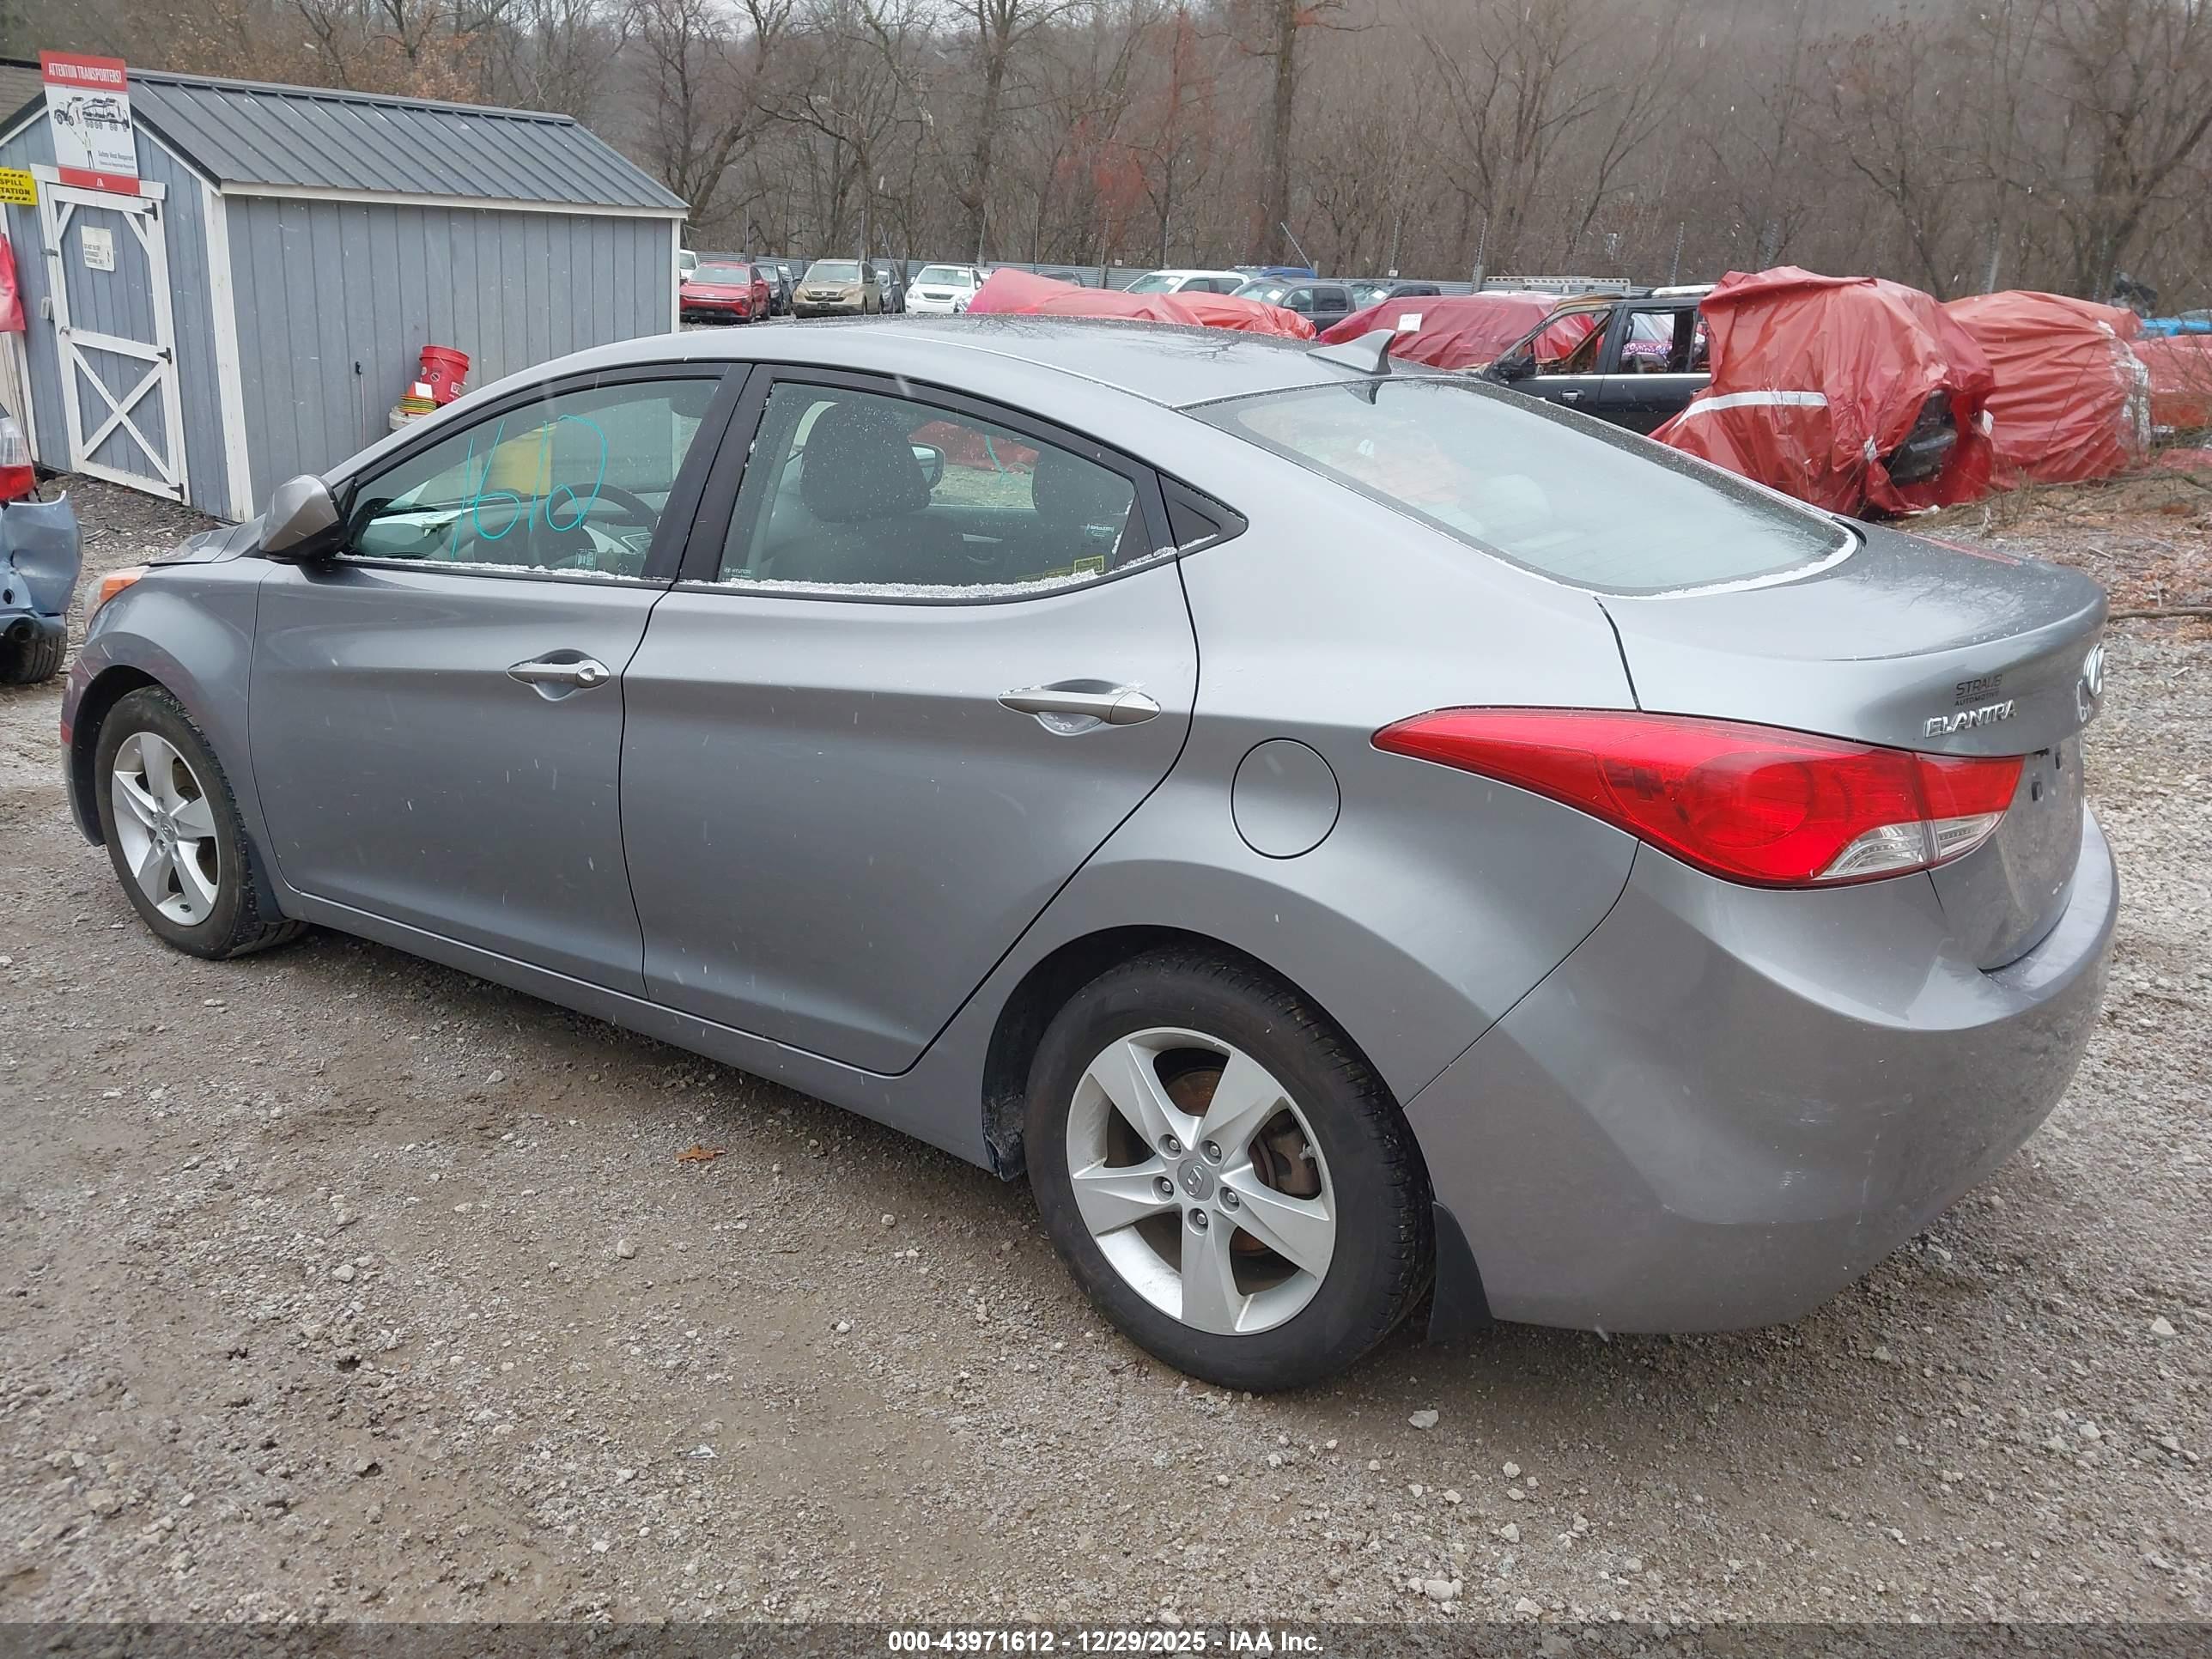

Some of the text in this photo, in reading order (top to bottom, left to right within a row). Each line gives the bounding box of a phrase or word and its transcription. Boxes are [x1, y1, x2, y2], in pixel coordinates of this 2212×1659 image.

[48, 63, 122, 83] ATTENTION TRANSPORTERS!
[0, 178, 24, 186] SPILL
[1923, 699, 2017, 738] ELANTRA
